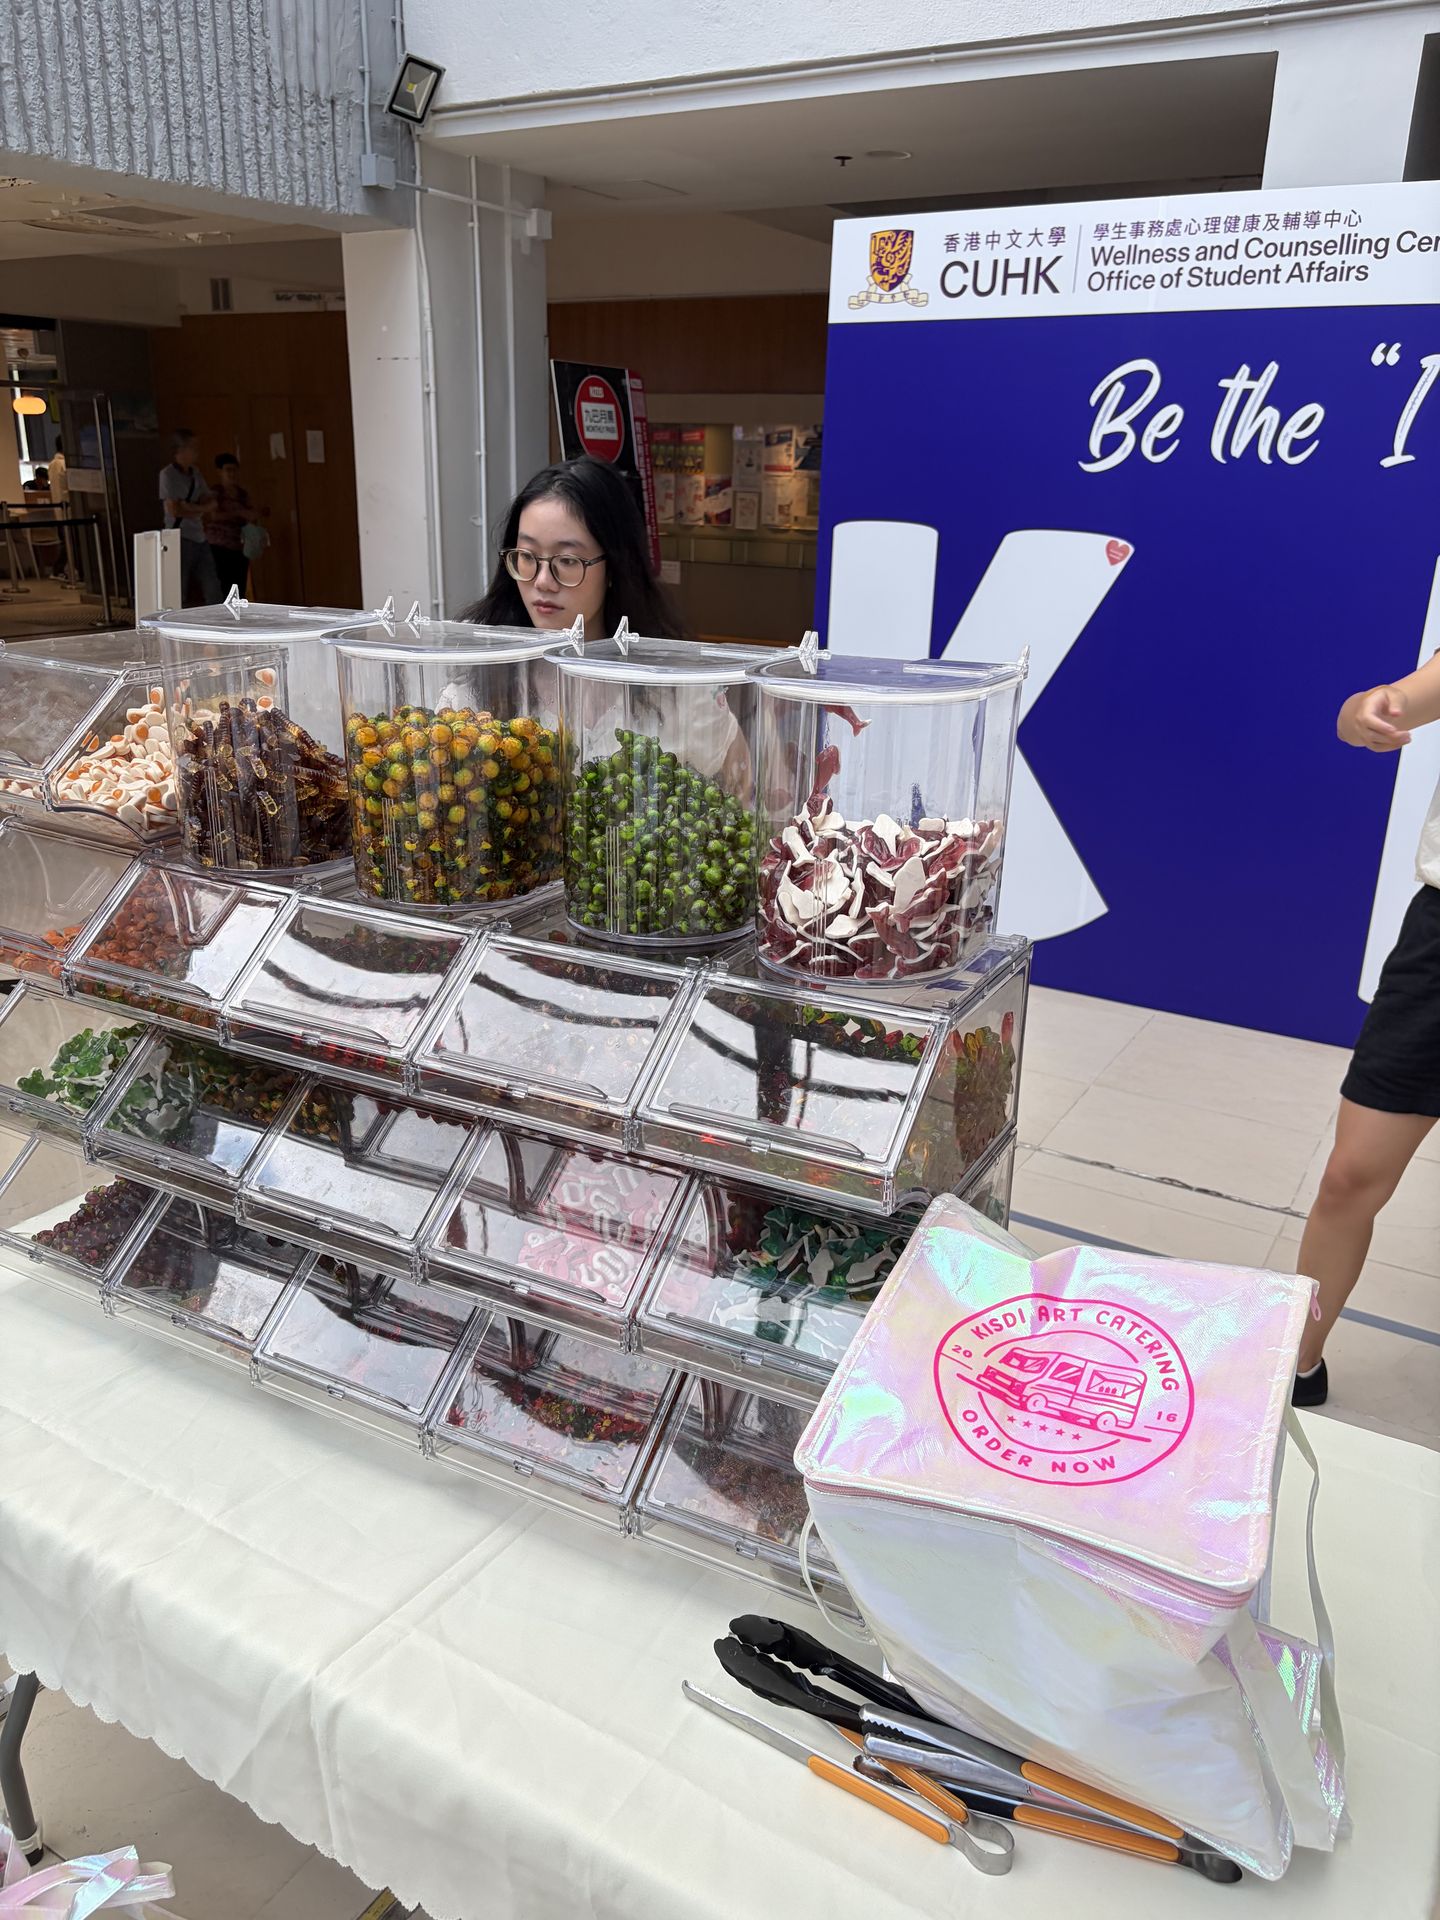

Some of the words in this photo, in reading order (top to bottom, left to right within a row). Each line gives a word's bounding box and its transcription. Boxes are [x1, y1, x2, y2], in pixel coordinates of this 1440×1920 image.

[943, 226, 1067, 254] 香港中文大學
[1092, 208, 1363, 242] 學生事務處心理健康及輔導中心
[1090, 243, 1190, 267] Wellness
[1195, 238, 1240, 262] and
[1244, 232, 1391, 260] Counselling
[940, 255, 1063, 299] CUHK
[1087, 269, 1156, 292] Office
[1160, 266, 1185, 290] of
[1186, 263, 1282, 288] Student
[1285, 259, 1370, 284] Affairs
[1077, 358, 1185, 474] Be
[1210, 360, 1326, 466] the
[951, 1344, 973, 1359] 20
[970, 1307, 1027, 1341] KISDI
[1037, 1304, 1084, 1323] ART
[1095, 1309, 1181, 1392] CATERING
[1156, 1410, 1178, 1423] 16
[961, 1408, 1034, 1468] ORDER
[1050, 1455, 1117, 1474] NOW
